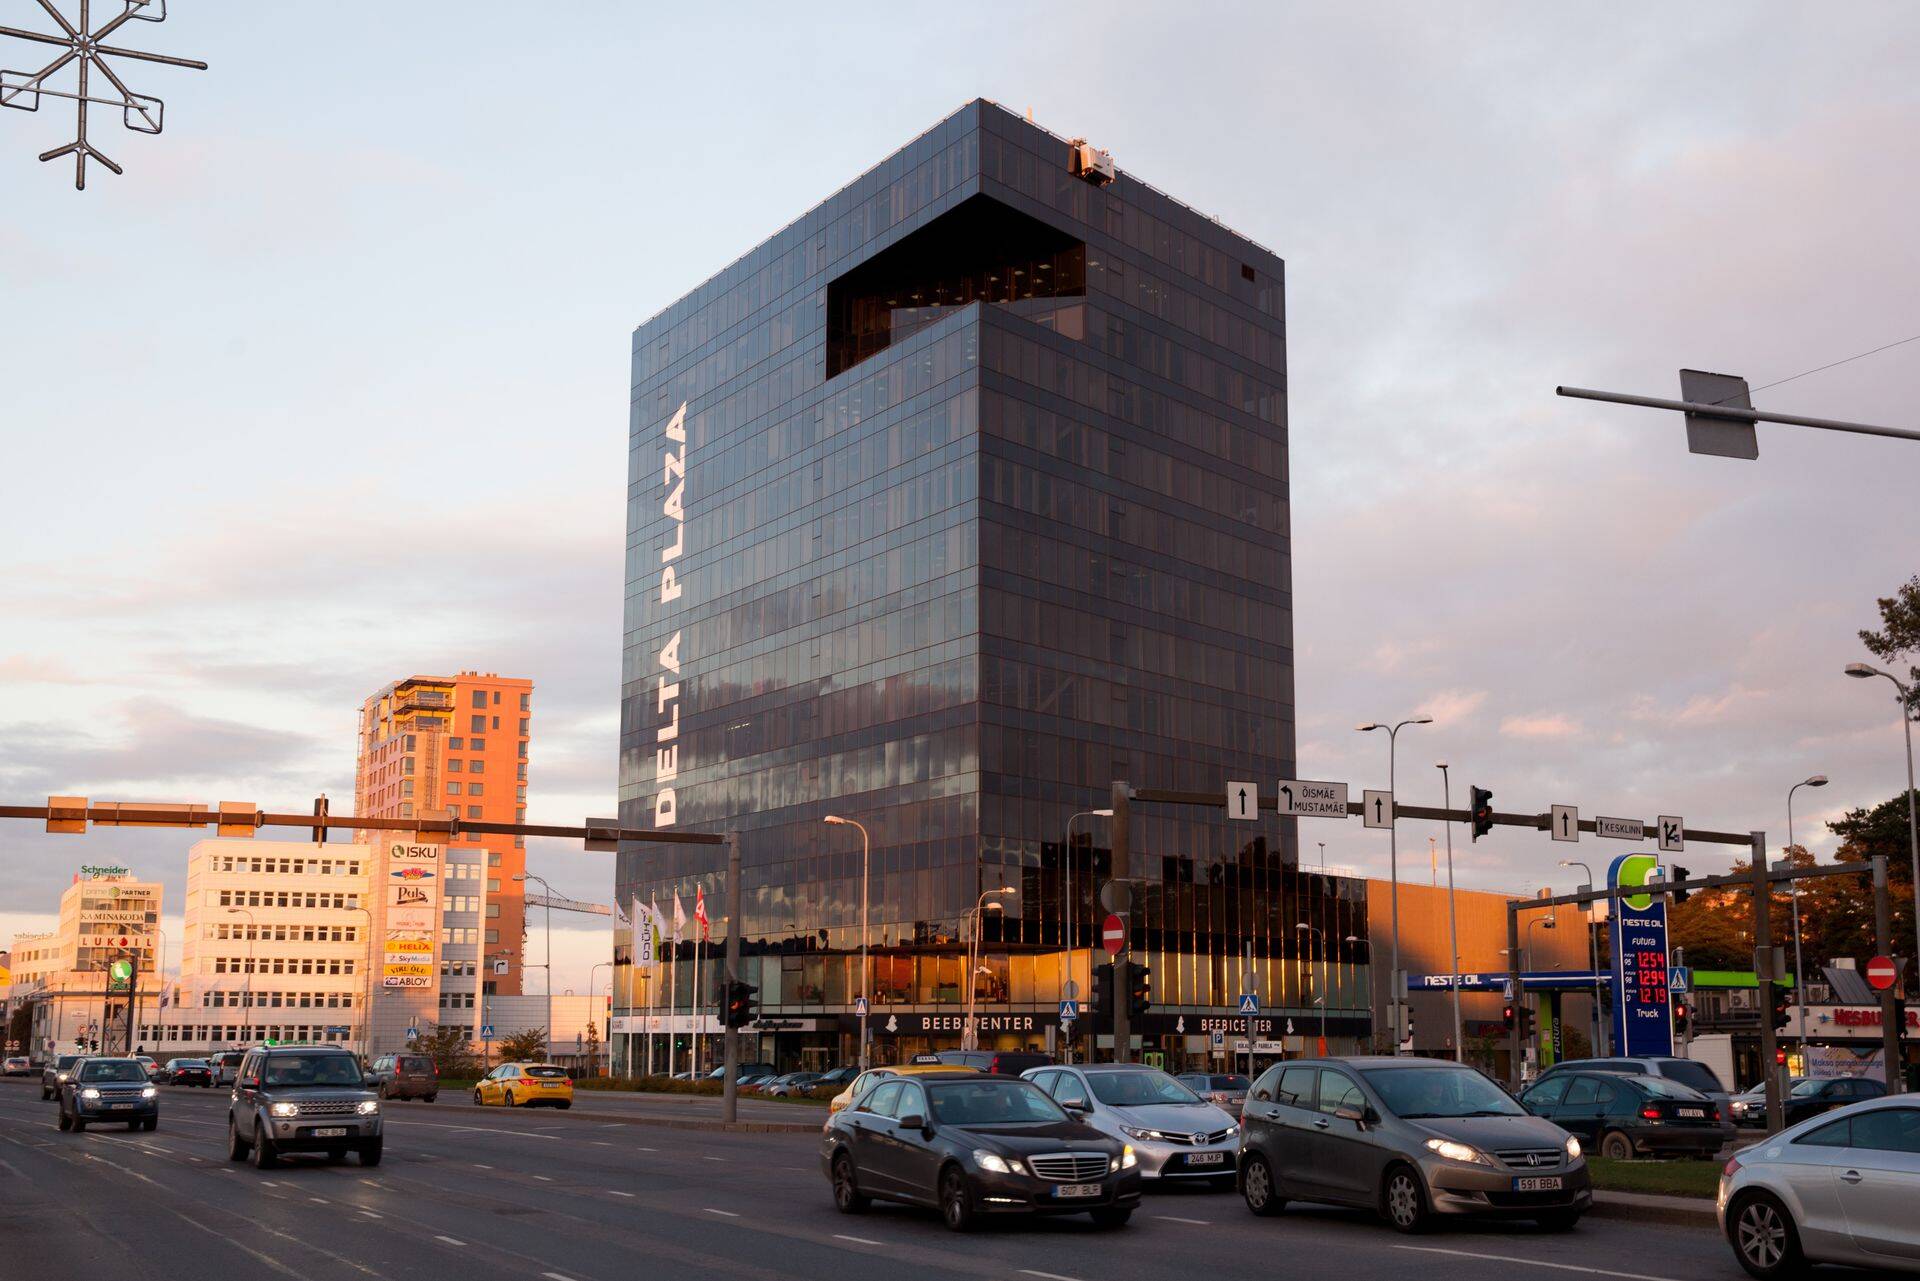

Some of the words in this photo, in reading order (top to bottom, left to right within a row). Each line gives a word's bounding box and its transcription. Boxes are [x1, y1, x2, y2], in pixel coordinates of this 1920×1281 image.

[661, 401, 687, 604] PLAZA
[655, 630, 681, 828] DELTA
[1302, 785, 1335, 799] ÕISMÄE
[1294, 801, 1344, 813] MUSTAMÄE
[1604, 823, 1641, 835] KESKLINN
[406, 846, 437, 858] ISKU
[81, 865, 128, 875] Schneider
[398, 887, 426, 900] Puls
[81, 913, 144, 921] KAMINAKODA
[1623, 919, 1650, 927] NESTE
[1651, 920, 1663, 928] OIL
[399, 942, 431, 951] HELIX
[1624, 958, 1631, 966] 95
[399, 977, 428, 986] ABLOY
[1425, 975, 1462, 986] NESTE
[1465, 974, 1483, 985] OIL
[1625, 976, 1633, 984] 98
[1636, 1008, 1659, 1018] Truck
[1834, 1008, 1920, 1028] HESBUER
[922, 1017, 1033, 1030] BEEBIENTER
[1201, 1018, 1272, 1032] BEEBICETER
[1191, 1154, 1204, 1163] 246
[1207, 1153, 1221, 1161] MJP
[1521, 1179, 1536, 1189] 591
[1540, 1178, 1559, 1189] BBA
